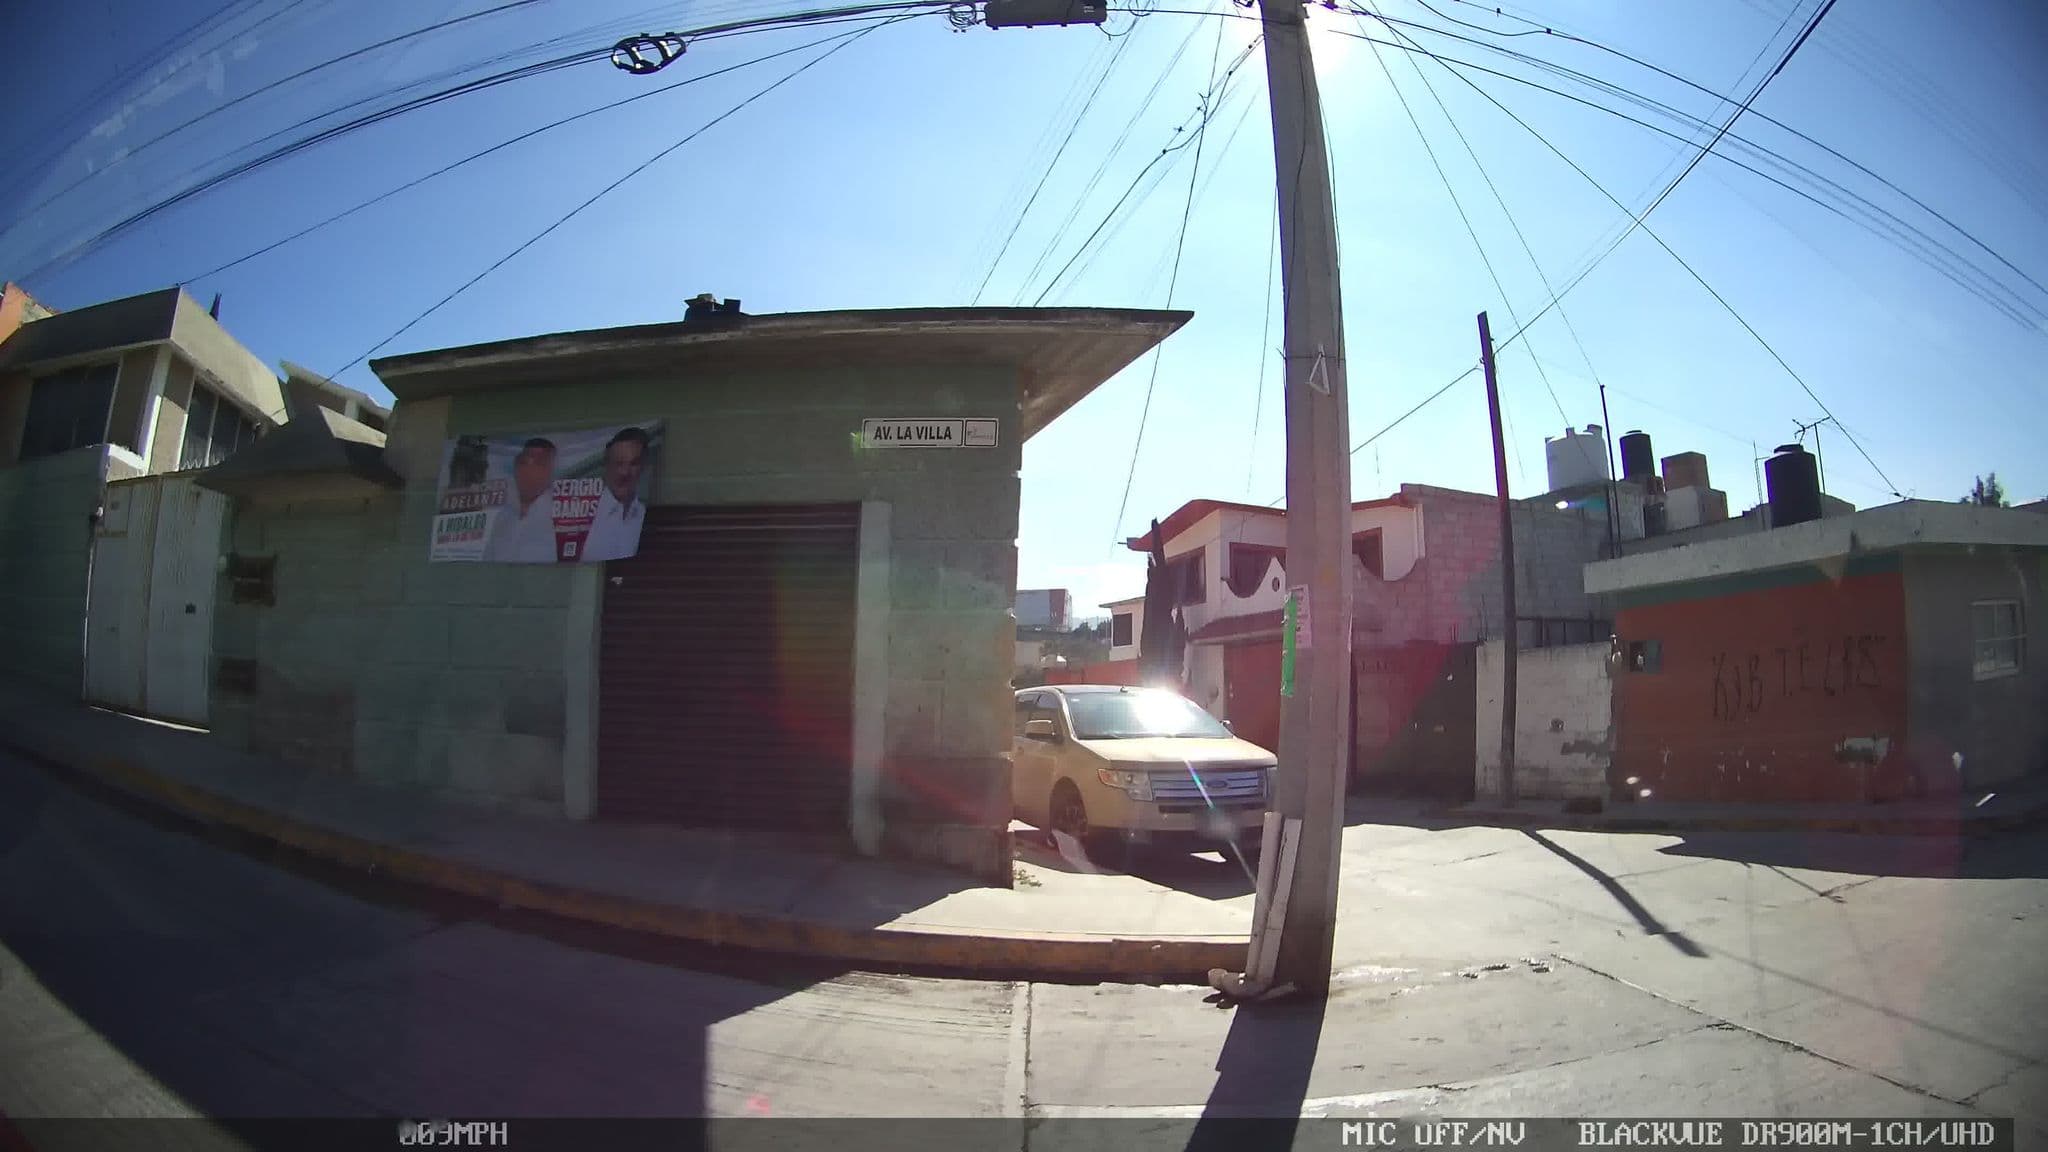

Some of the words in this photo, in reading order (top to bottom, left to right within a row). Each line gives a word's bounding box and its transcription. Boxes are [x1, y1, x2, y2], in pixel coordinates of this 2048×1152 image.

[874, 426, 892, 440] AV.
[897, 426, 912, 440] LA
[916, 426, 952, 440] VILLA
[552, 478, 604, 497] SERGIO
[551, 496, 599, 519] BAÑOS
